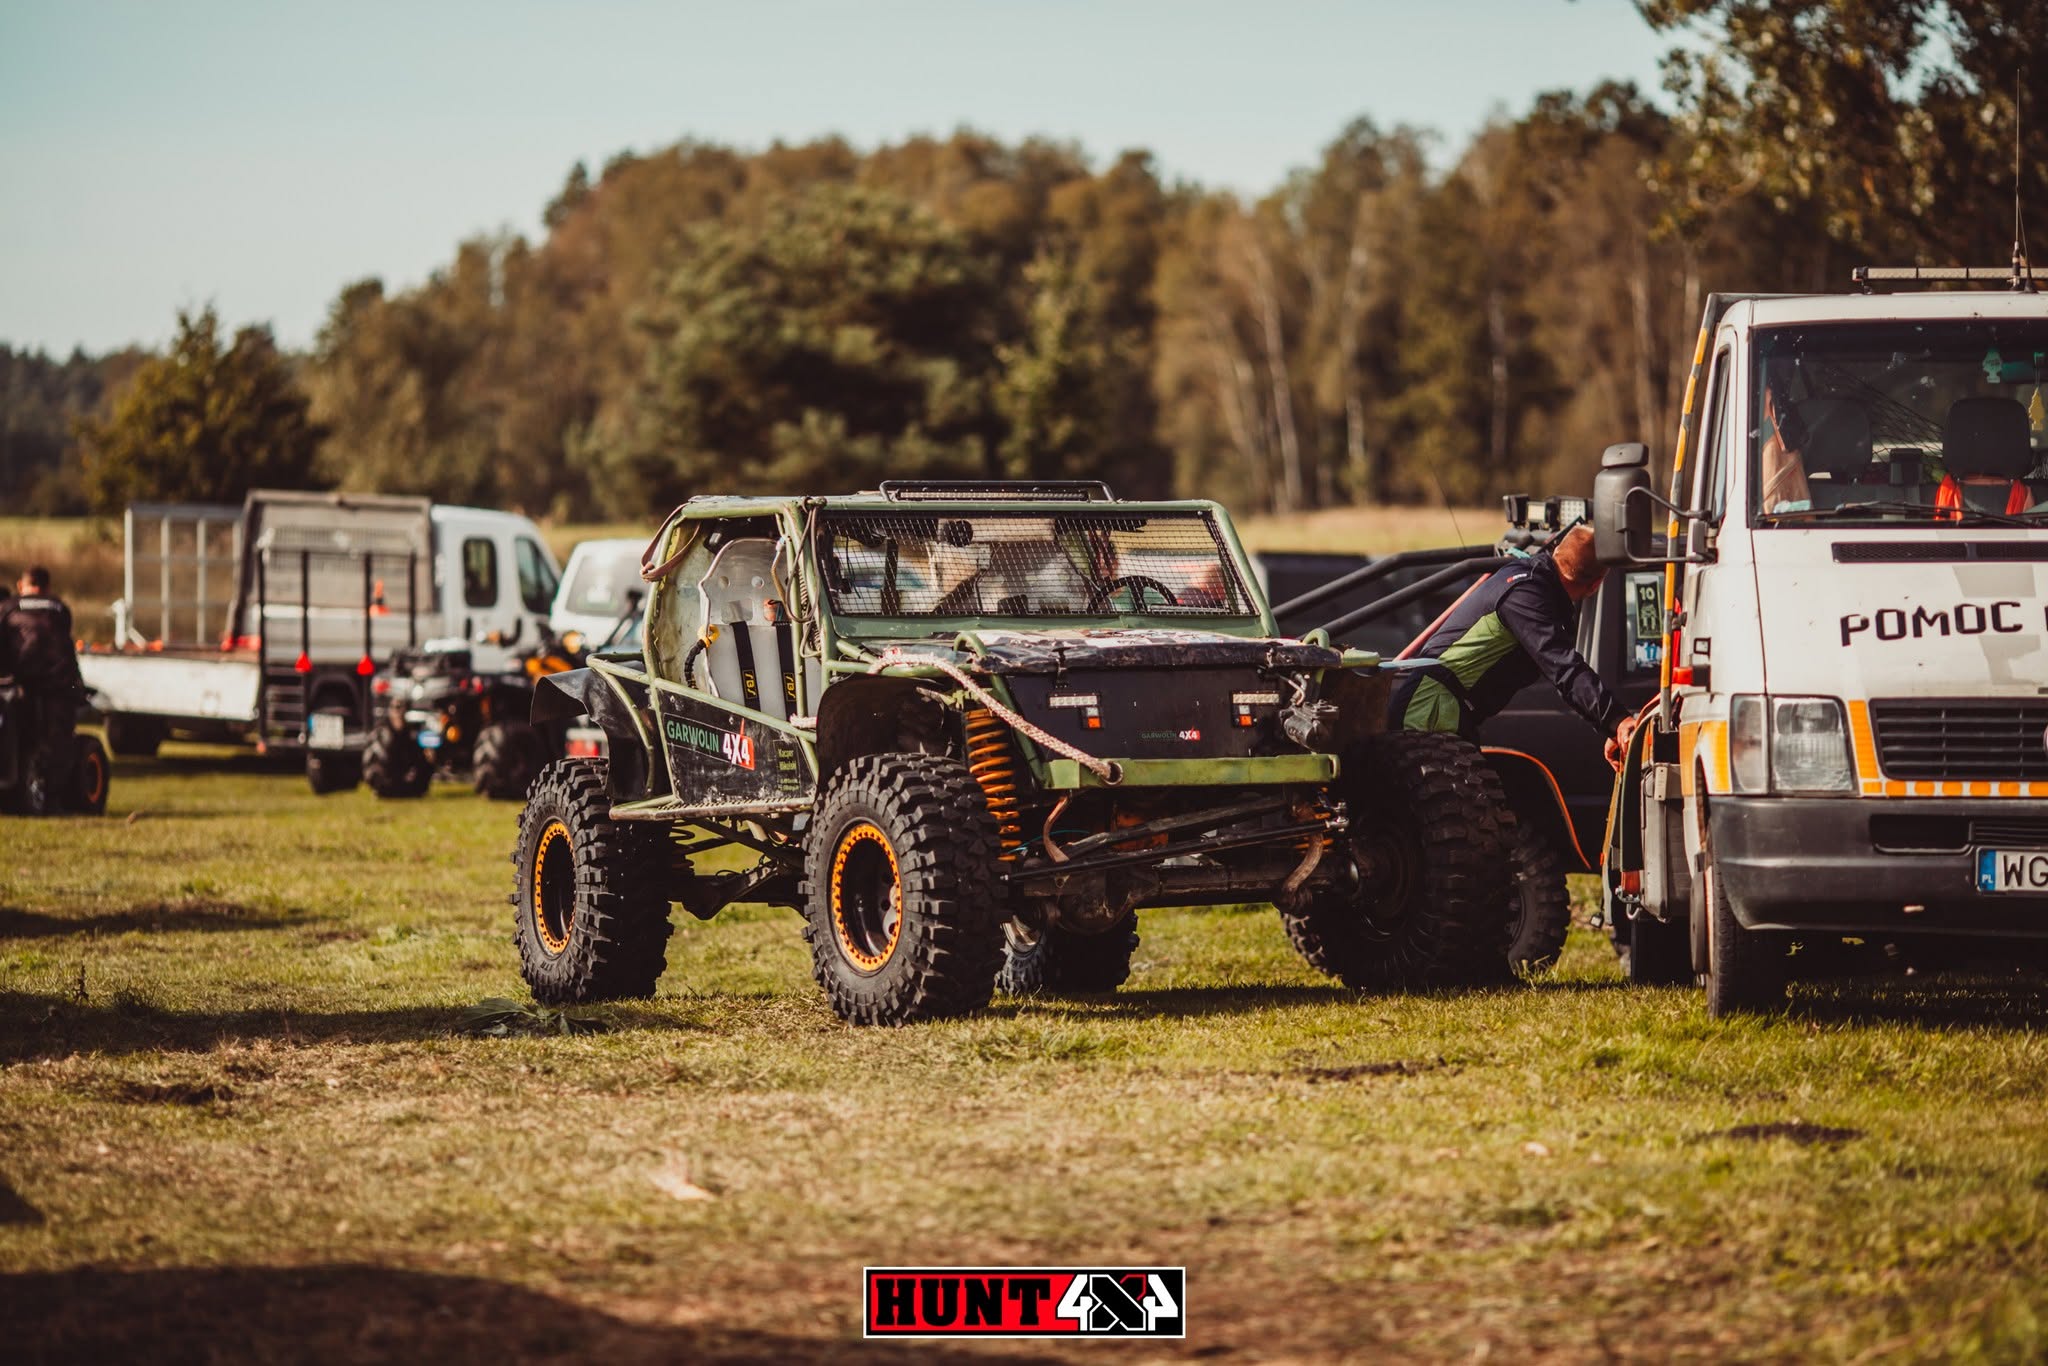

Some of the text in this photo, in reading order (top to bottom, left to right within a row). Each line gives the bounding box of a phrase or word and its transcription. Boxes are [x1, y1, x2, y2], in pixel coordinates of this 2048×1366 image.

[1839, 601, 2023, 647] POMOC
[666, 720, 720, 753] GARWOLIN
[1981, 874, 1994, 884] PL
